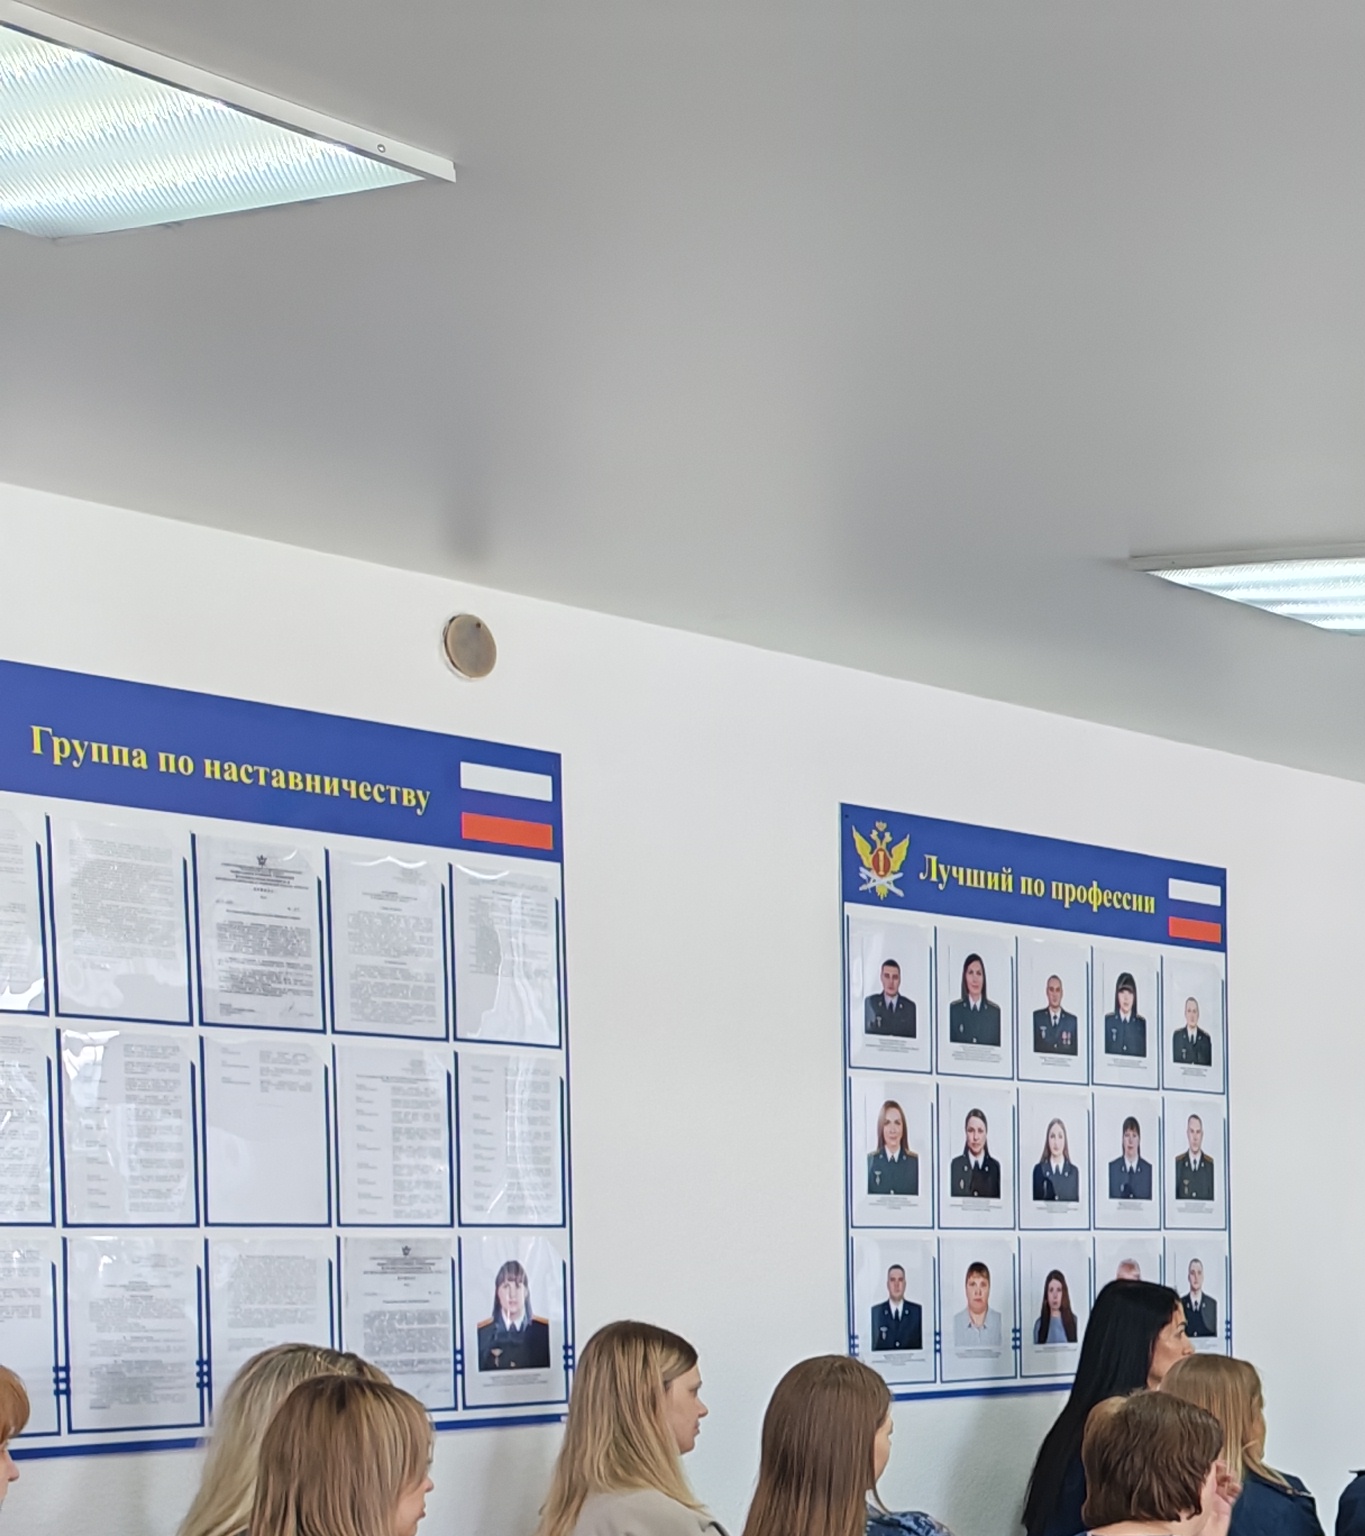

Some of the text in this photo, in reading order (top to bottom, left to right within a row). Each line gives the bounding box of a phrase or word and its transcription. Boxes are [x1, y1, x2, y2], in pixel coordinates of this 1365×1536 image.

[30, 725, 431, 816] Группа по наставничеству
[919, 854, 1156, 914] Лучший по профессии
